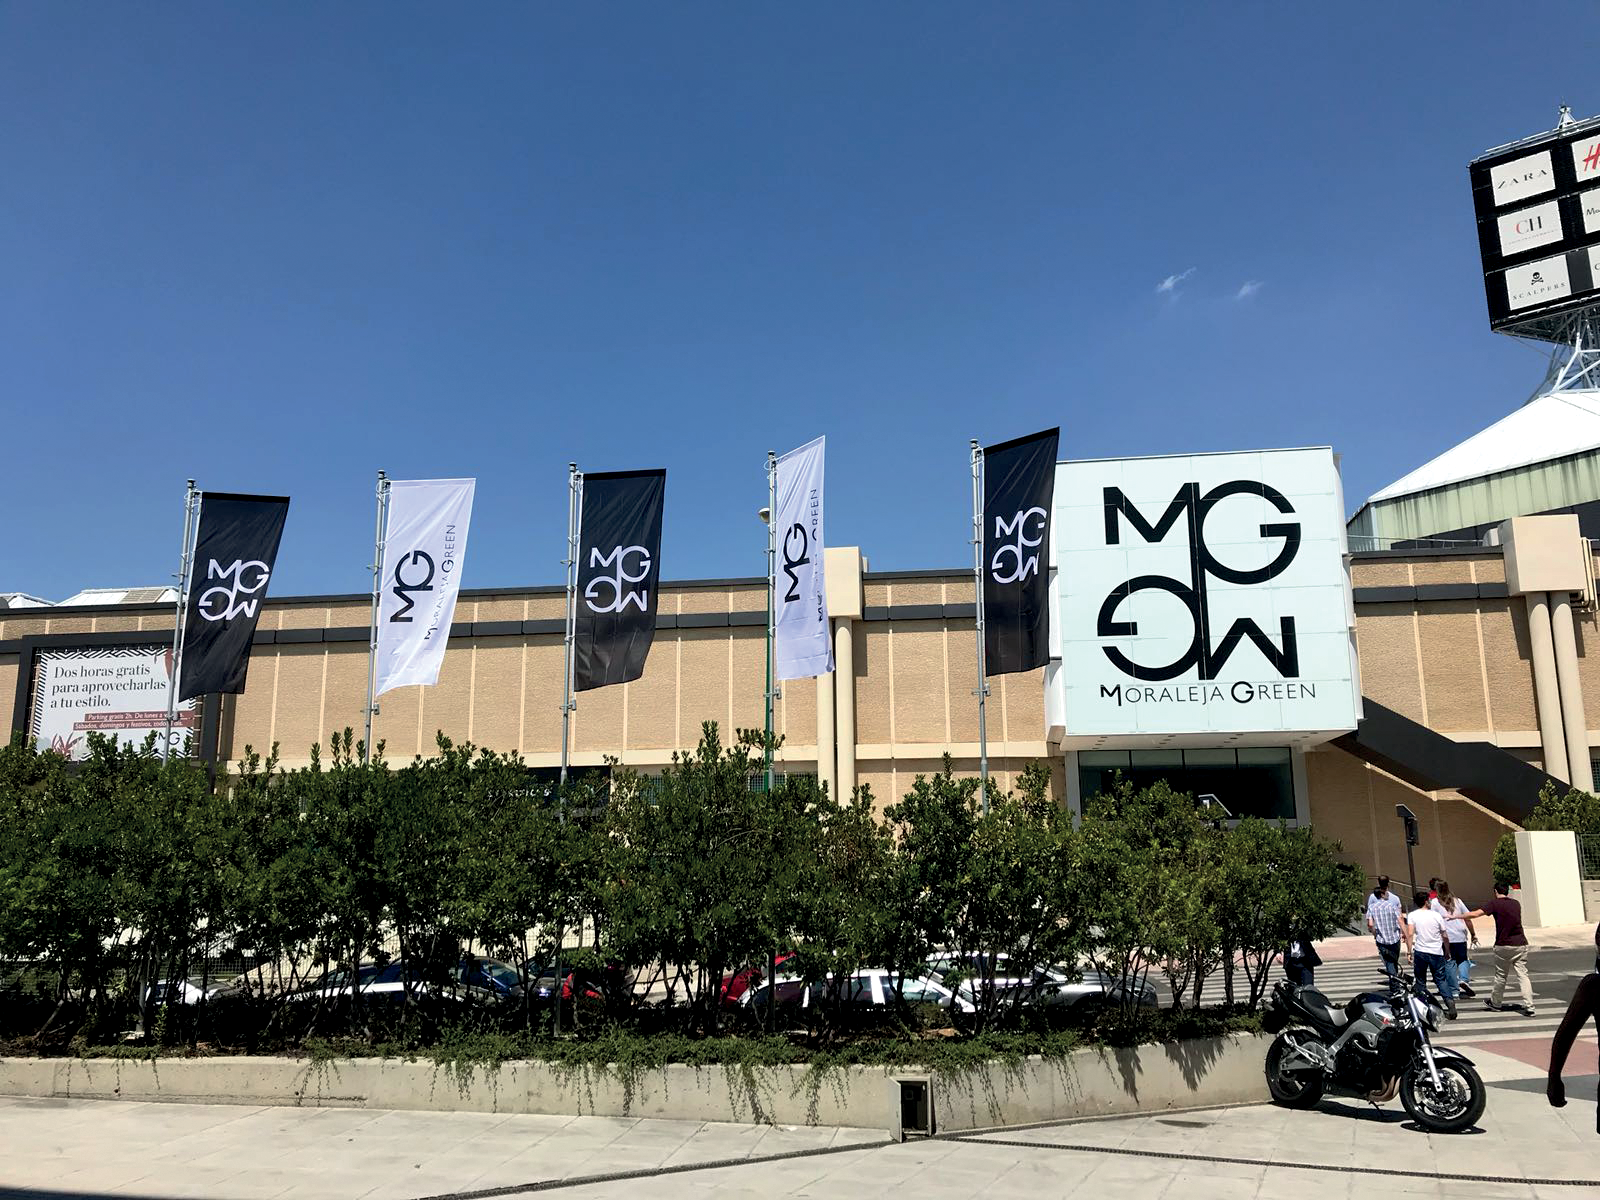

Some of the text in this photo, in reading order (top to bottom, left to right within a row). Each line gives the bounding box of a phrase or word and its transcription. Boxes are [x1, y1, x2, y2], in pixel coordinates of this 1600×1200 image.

[1497, 169, 1547, 189] ZARA
[1512, 281, 1566, 300] SCALPERS
[441, 524, 455, 573] GREEN
[783, 522, 810, 603] MG
[390, 550, 435, 623] MG
[54, 664, 151, 679] Dos horas gratis
[52, 678, 166, 696] para aprovecharlas
[1100, 681, 1316, 706] MORALEJA GREEN
[60, 698, 72, 708] tu
[75, 695, 111, 708] estilo.
[88, 713, 108, 721] Parking
[99, 721, 125, 729] domingos
